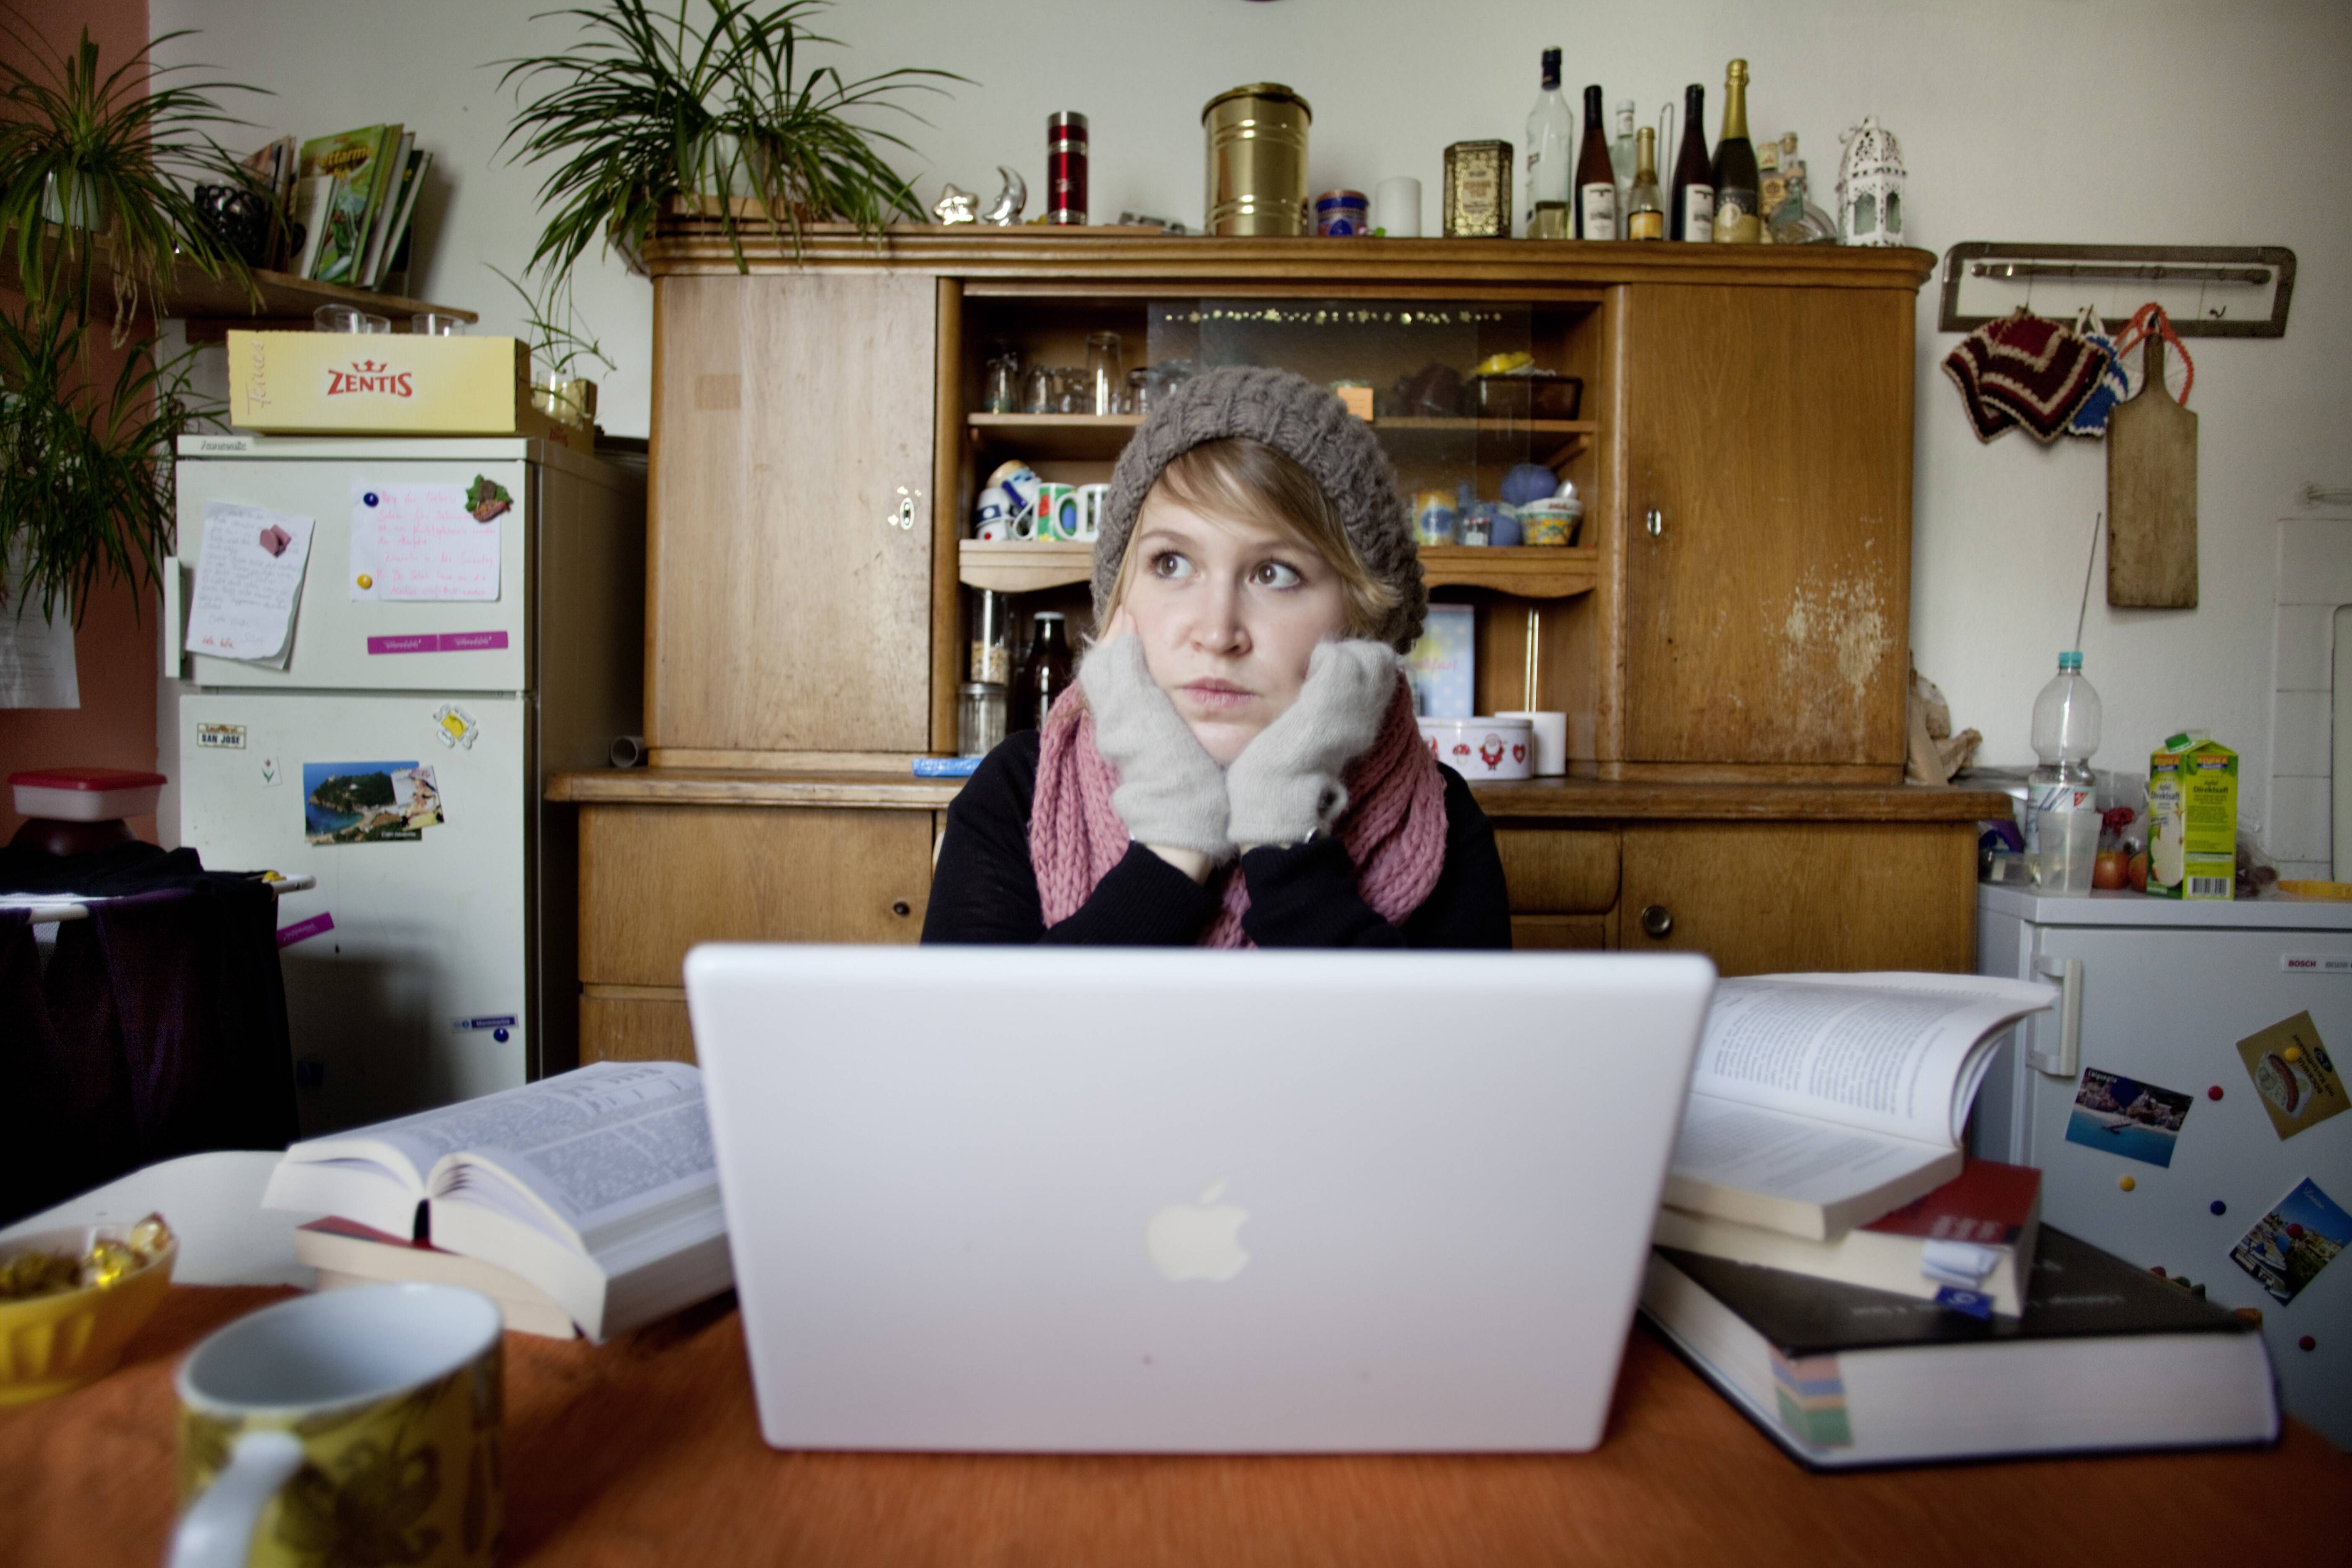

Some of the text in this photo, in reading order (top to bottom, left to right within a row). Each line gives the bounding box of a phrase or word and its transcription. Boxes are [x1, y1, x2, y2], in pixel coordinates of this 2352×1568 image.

[328, 369, 413, 398] ZENTIS
[201, 734, 240, 744] SAN JOSE
[2150, 791, 2180, 800] Direktsaft
